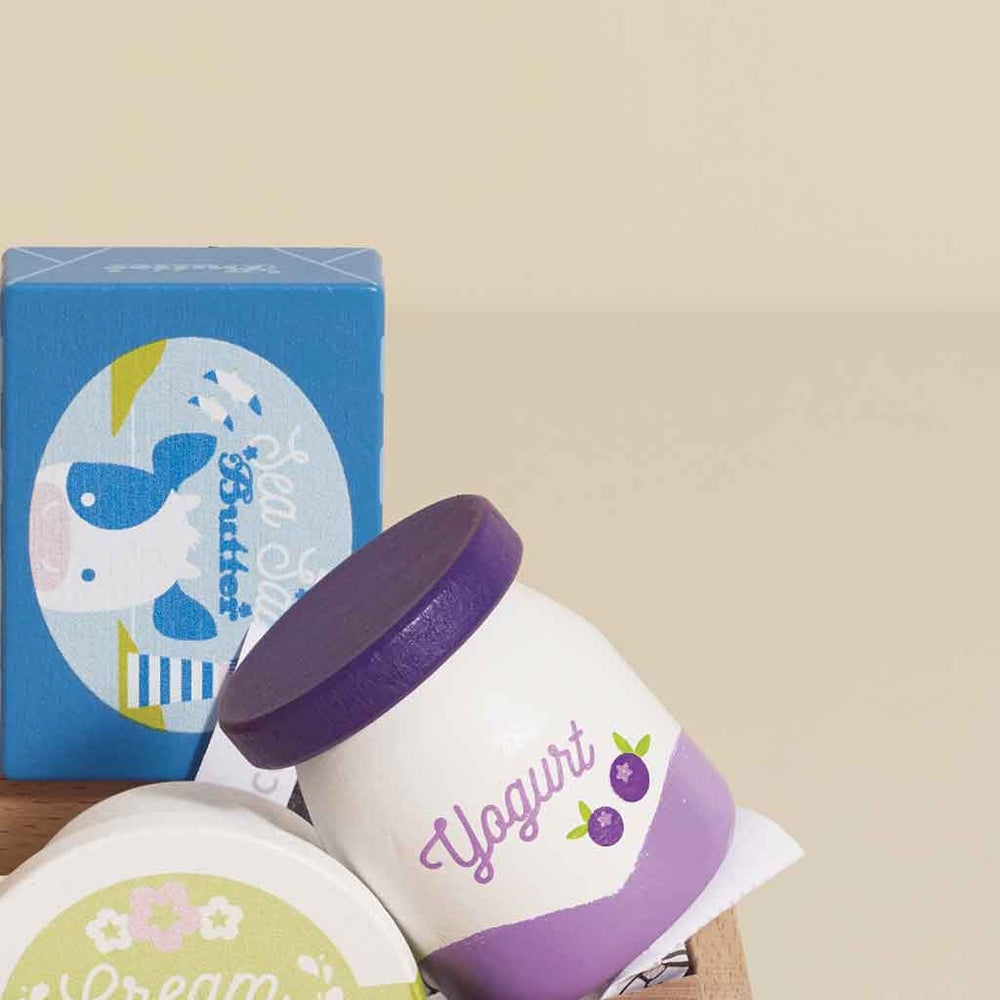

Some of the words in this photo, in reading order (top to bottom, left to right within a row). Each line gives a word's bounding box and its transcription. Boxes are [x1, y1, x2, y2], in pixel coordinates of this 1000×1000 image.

[219, 453, 255, 620] Butter
[255, 427, 309, 529] Sea
[256, 545, 330, 632] Sa
[420, 720, 595, 884] Yogurt
